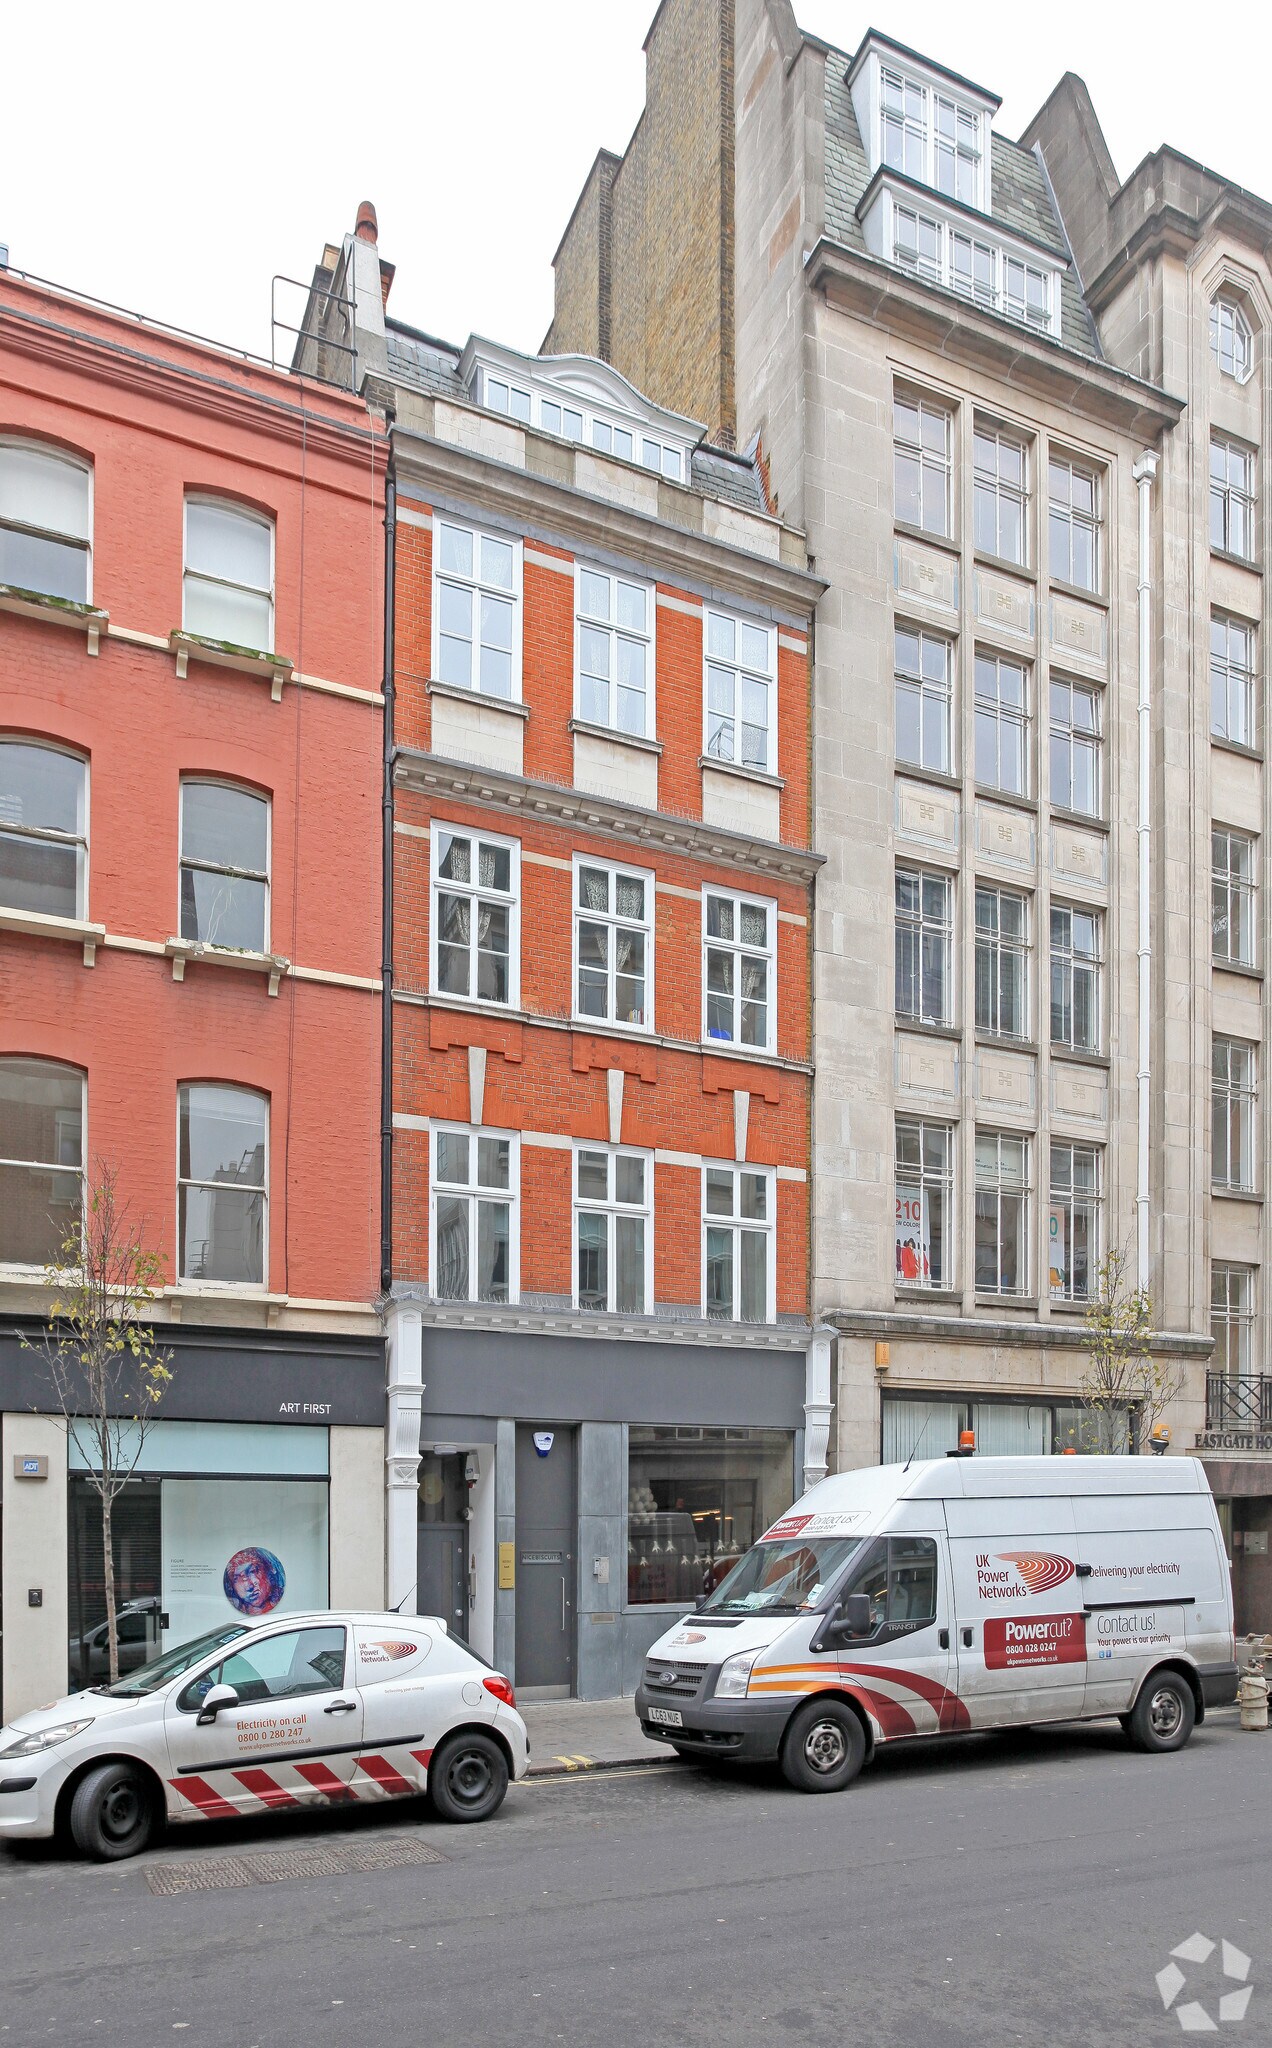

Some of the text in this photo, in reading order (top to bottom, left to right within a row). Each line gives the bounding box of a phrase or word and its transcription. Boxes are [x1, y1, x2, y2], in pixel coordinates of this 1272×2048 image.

[279, 1402, 332, 1414] ART FIRST
[1194, 1433, 1253, 1449] EASTGATE
[24, 1462, 39, 1471] ADT
[809, 1514, 860, 1526] Contact us!
[975, 1554, 990, 1568] UK
[977, 1569, 1009, 1583] Power
[1089, 1562, 1181, 1579] Delivering your electricity
[978, 1582, 1027, 1599] Networks
[887, 1623, 917, 1631] TRANSIT
[1005, 1617, 1073, 1641] Powercut?
[1097, 1612, 1156, 1634] Contact us!
[1097, 1632, 1171, 1648] Your power is our priority
[1005, 1642, 1057, 1654] 0800 028 0247
[361, 1655, 390, 1664] Networks
[1006, 1654, 1059, 1666] ukpowernetworks.co.uk
[236, 1714, 307, 1731] Electricity on call
[237, 1727, 303, 1743] 0800 0 280 247
[238, 1736, 312, 1751] www.ukpowernetworks.co.uk
